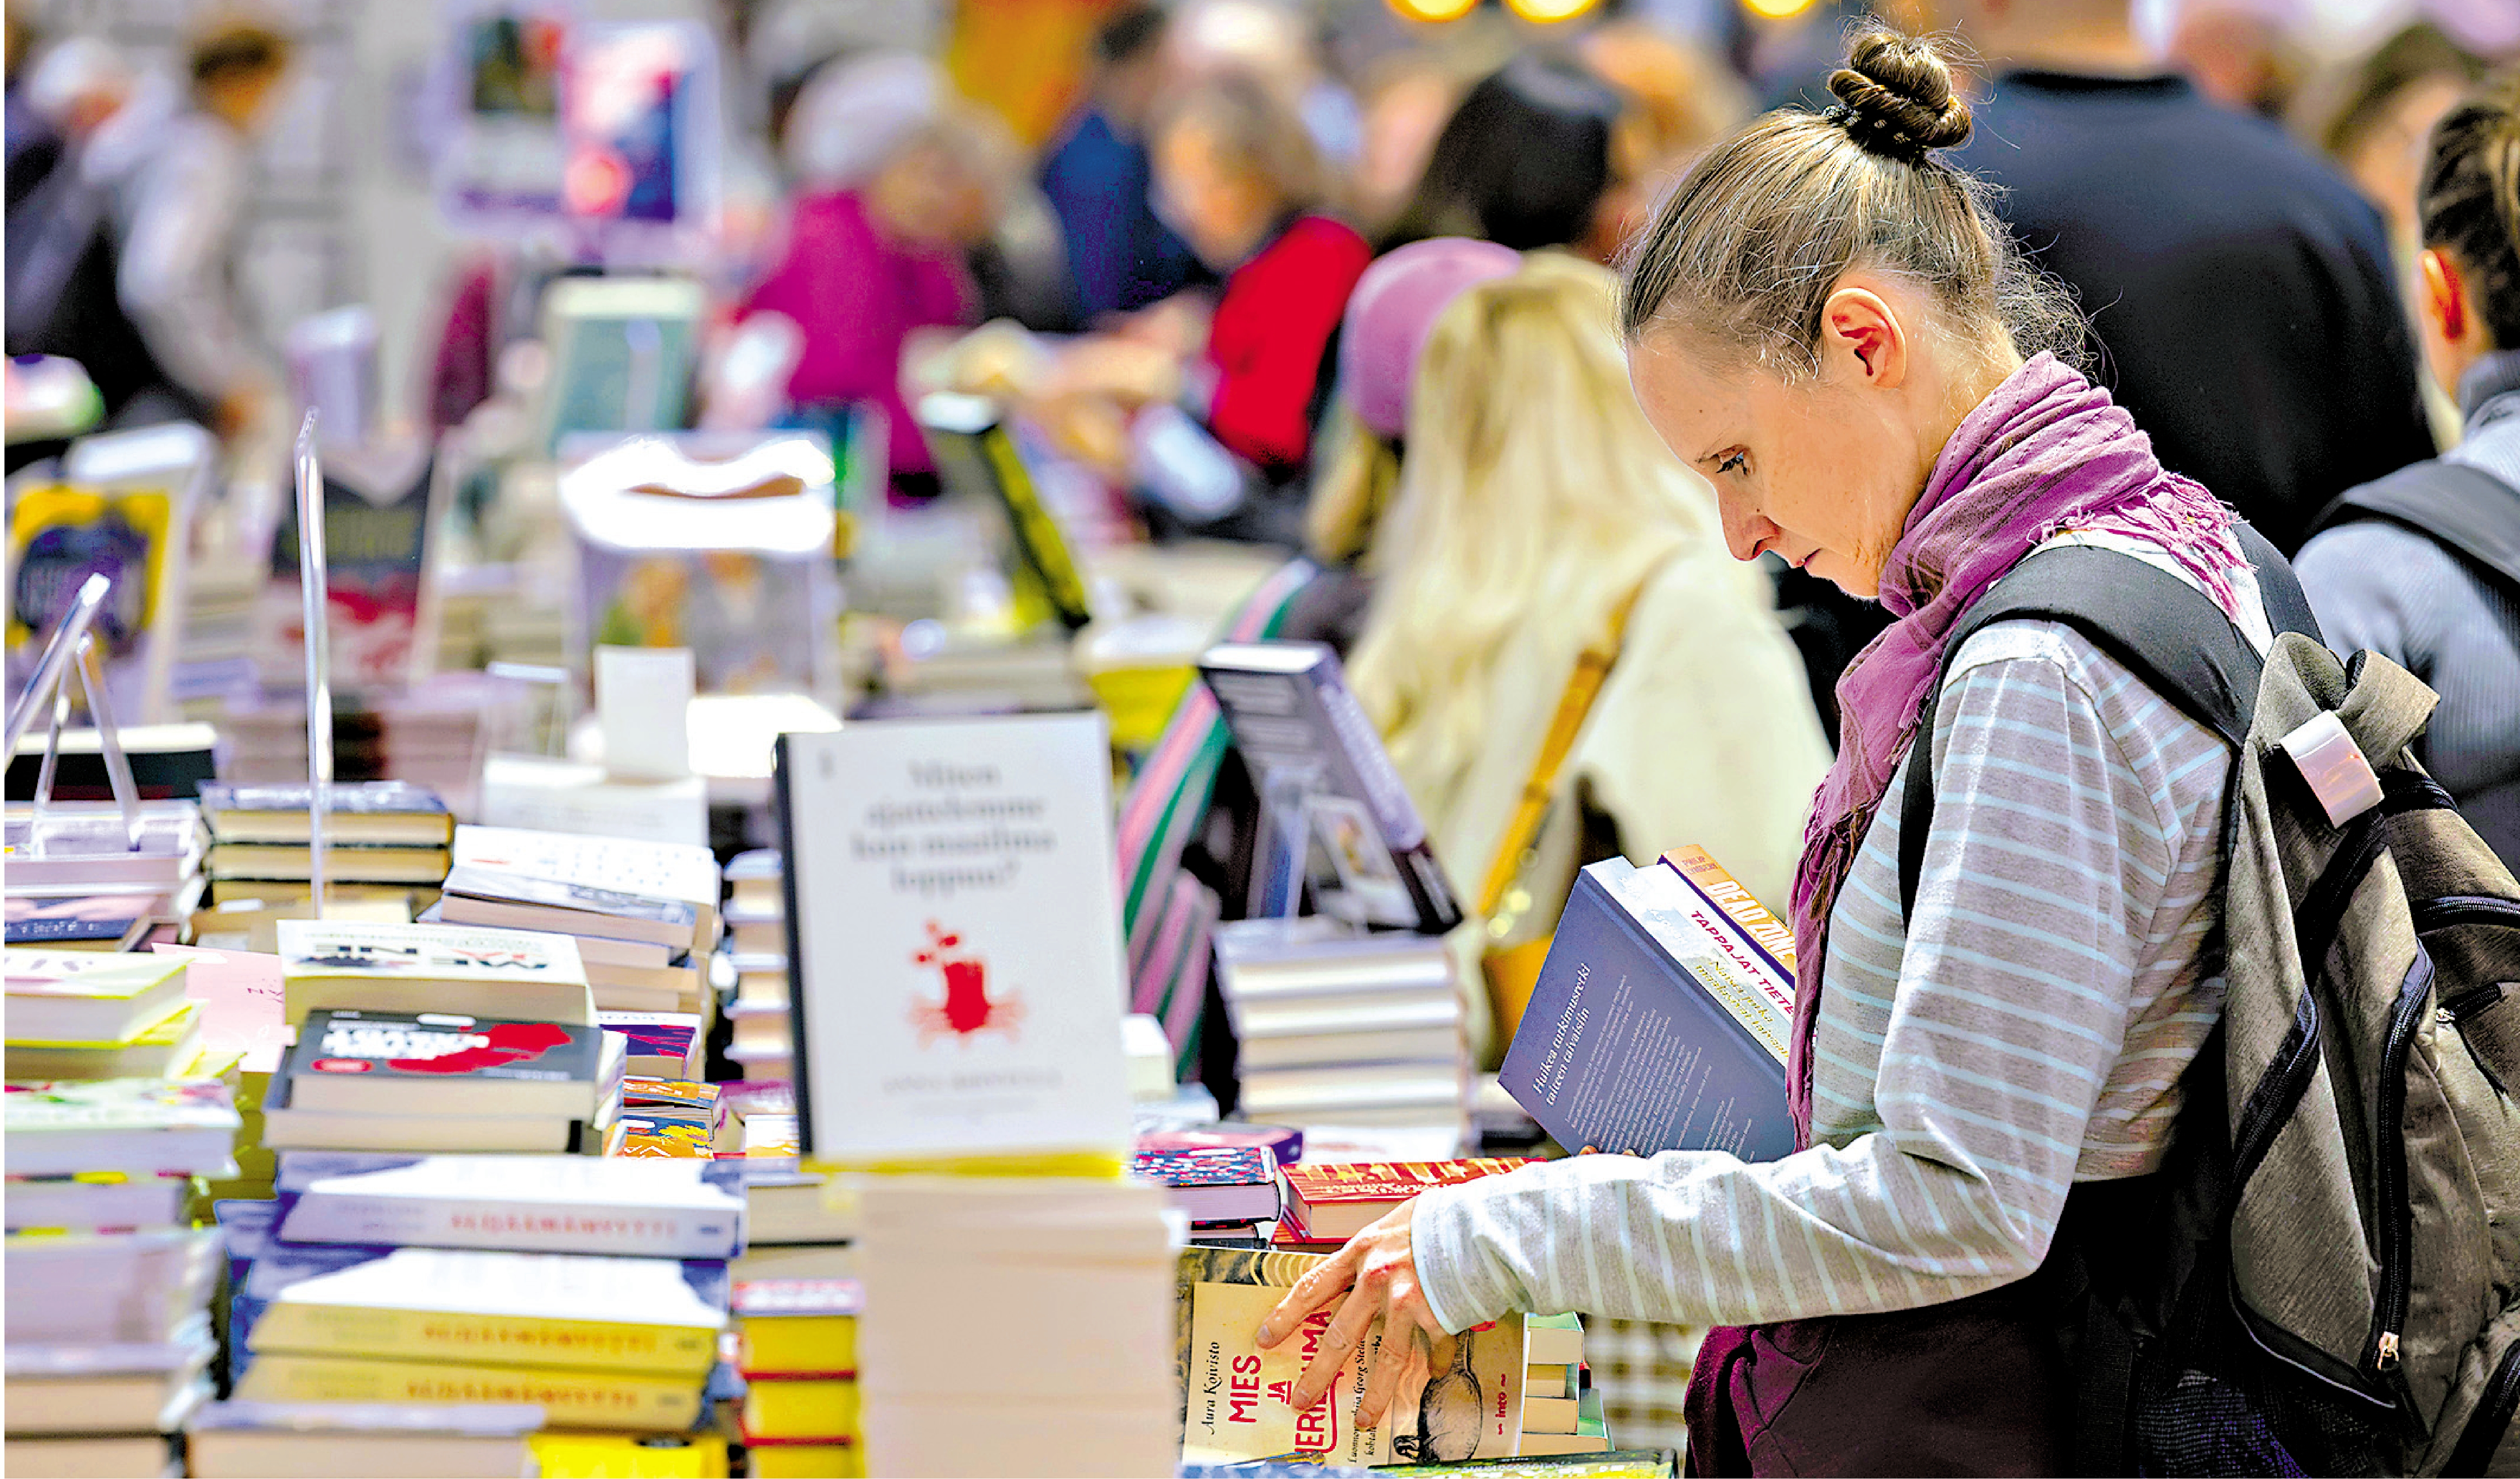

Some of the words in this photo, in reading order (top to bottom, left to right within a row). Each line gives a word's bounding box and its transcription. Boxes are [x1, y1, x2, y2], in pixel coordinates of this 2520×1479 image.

[1705, 880, 1769, 922] DEAD
[1691, 911, 1761, 975] TAPPAJAT
[1552, 962, 1590, 1049] tutkimusretki
[1203, 1341, 1223, 1395] Koivisto
[1228, 1355, 1262, 1423] MIES
[1353, 1366, 1368, 1394] Georg
[1267, 1380, 1287, 1403] JA
[1495, 1391, 1507, 1418] into
[1200, 1399, 1216, 1435] Aura
